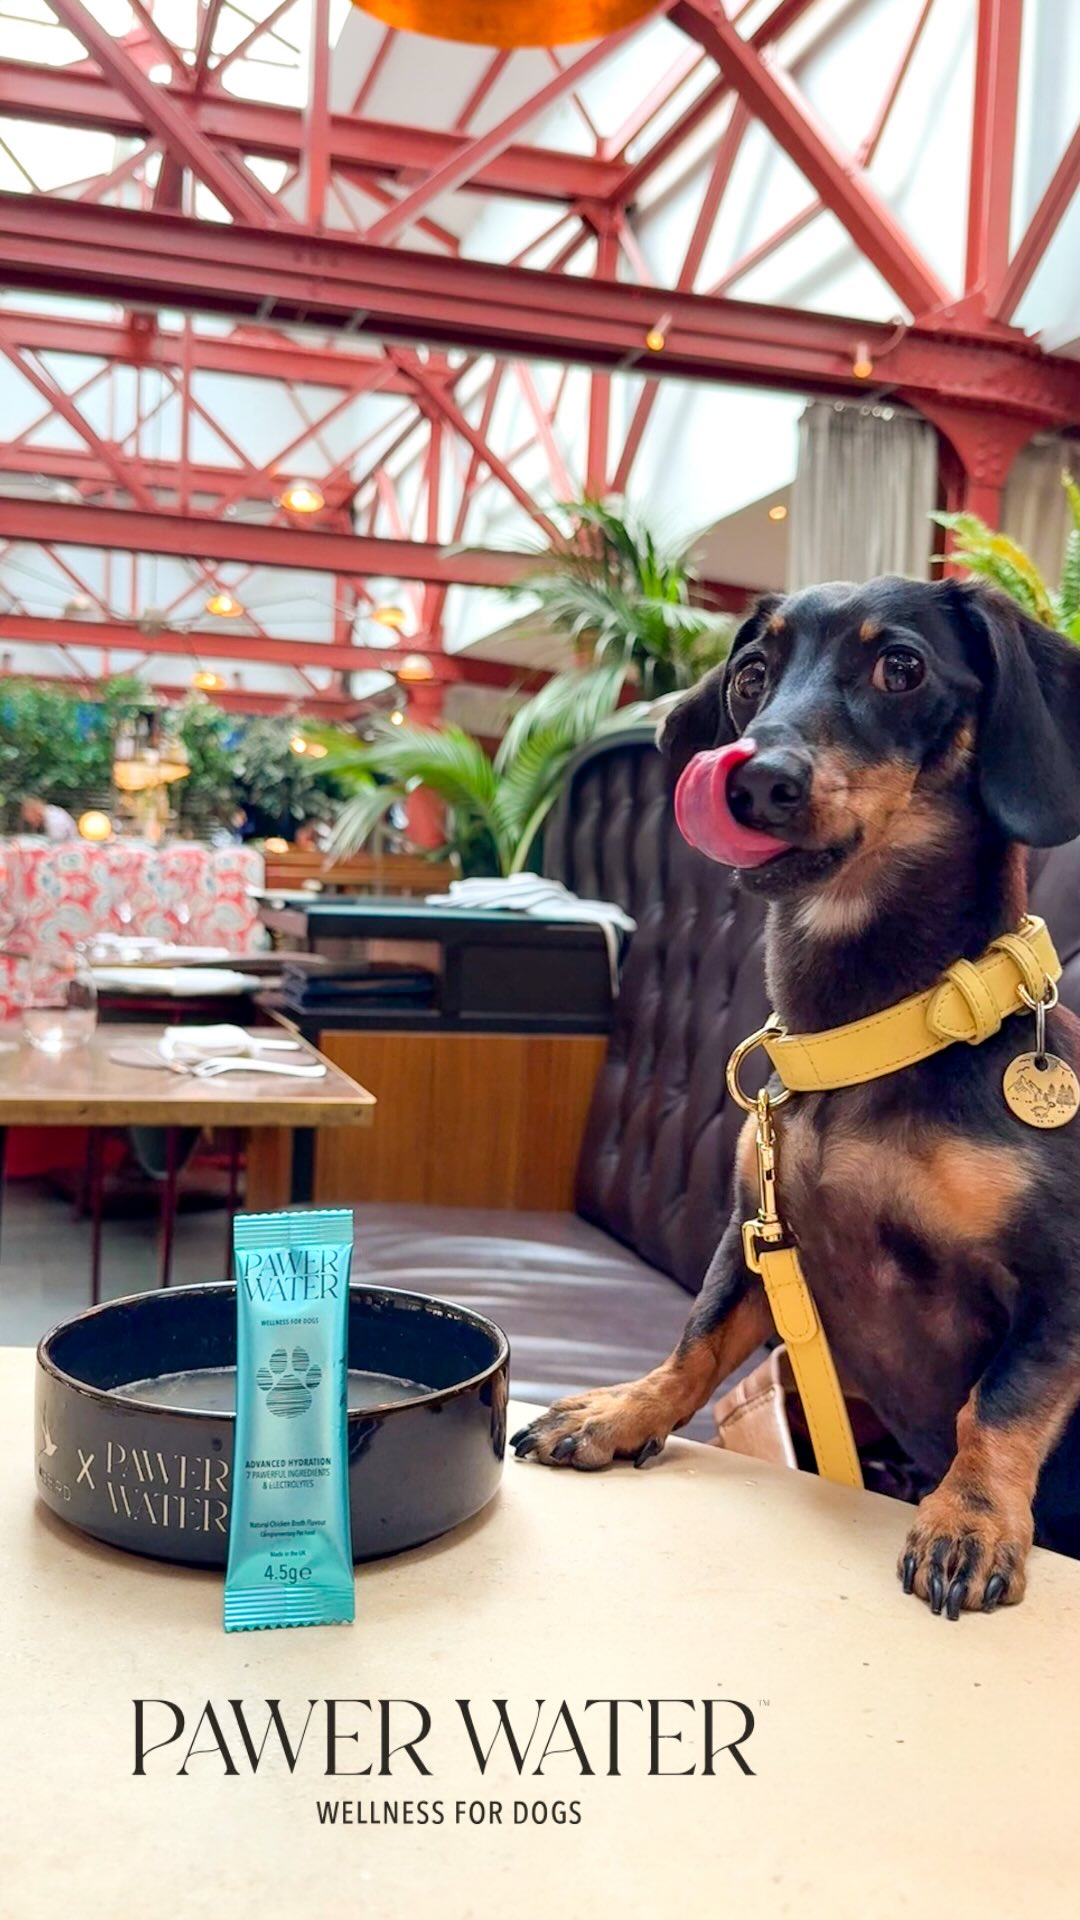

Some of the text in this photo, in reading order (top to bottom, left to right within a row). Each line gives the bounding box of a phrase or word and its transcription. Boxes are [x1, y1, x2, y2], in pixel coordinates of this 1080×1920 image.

[244, 1250, 338, 1276] PAWER
[244, 1274, 338, 1302] WATER
[106, 1441, 229, 1493] PAWER
[245, 1458, 331, 1469] ADVANCED HYDRATION
[287, 1468, 330, 1477] INGREDIENTS
[262, 1480, 314, 1490] & ELECTROLYTES
[107, 1481, 228, 1533] WATER
[269, 1520, 290, 1528] Chicken
